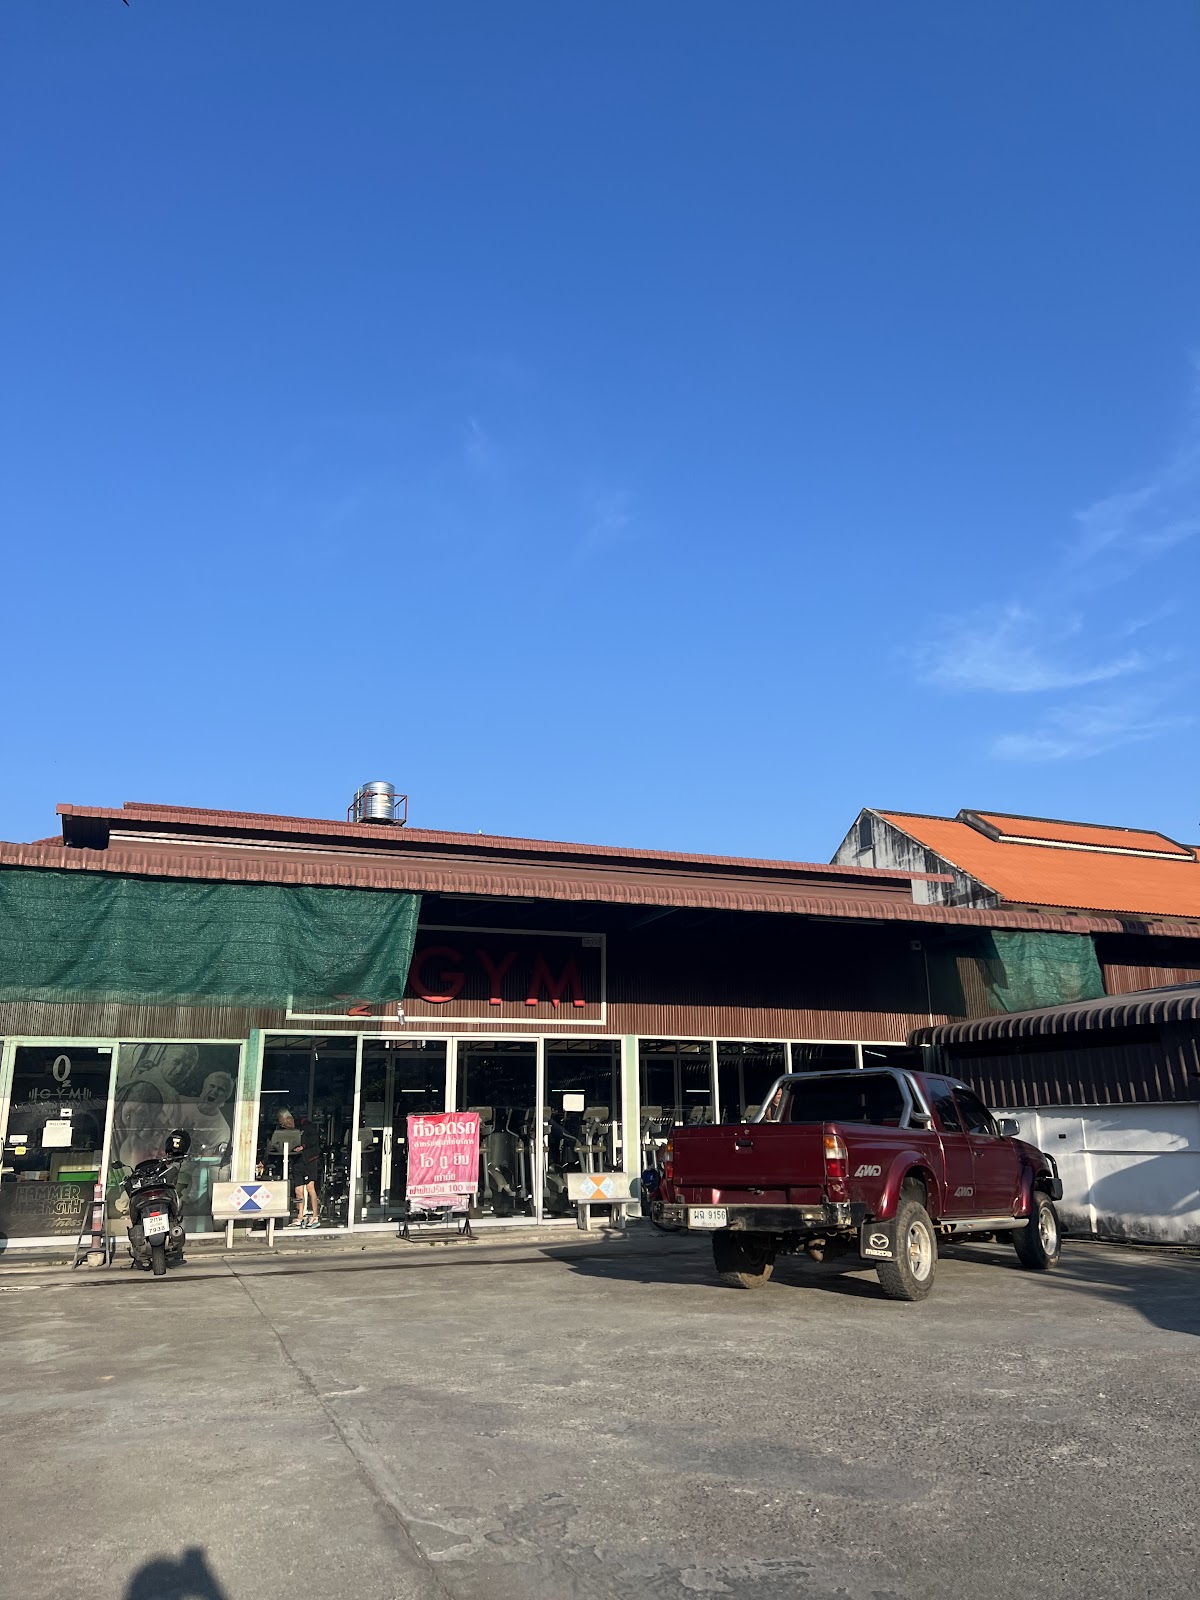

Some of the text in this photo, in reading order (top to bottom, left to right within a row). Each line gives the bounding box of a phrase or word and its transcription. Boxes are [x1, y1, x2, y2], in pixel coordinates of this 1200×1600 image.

[409, 944, 586, 1008] GYM
[39, 1087, 81, 1100] GYM
[413, 1118, 476, 1137] ที่จอดรถ
[420, 1152, 470, 1170] โอ ทู ยิม
[433, 1170, 456, 1182] เท่านั้น
[854, 1164, 882, 1178] 4WD
[16, 1184, 81, 1200] HAMMER
[448, 1184, 464, 1193] 100
[954, 1186, 974, 1198] 4WD
[11, 1199, 82, 1216] STRENGTH
[708, 1210, 726, 1221] 9156
[865, 1248, 893, 1258] mazda
